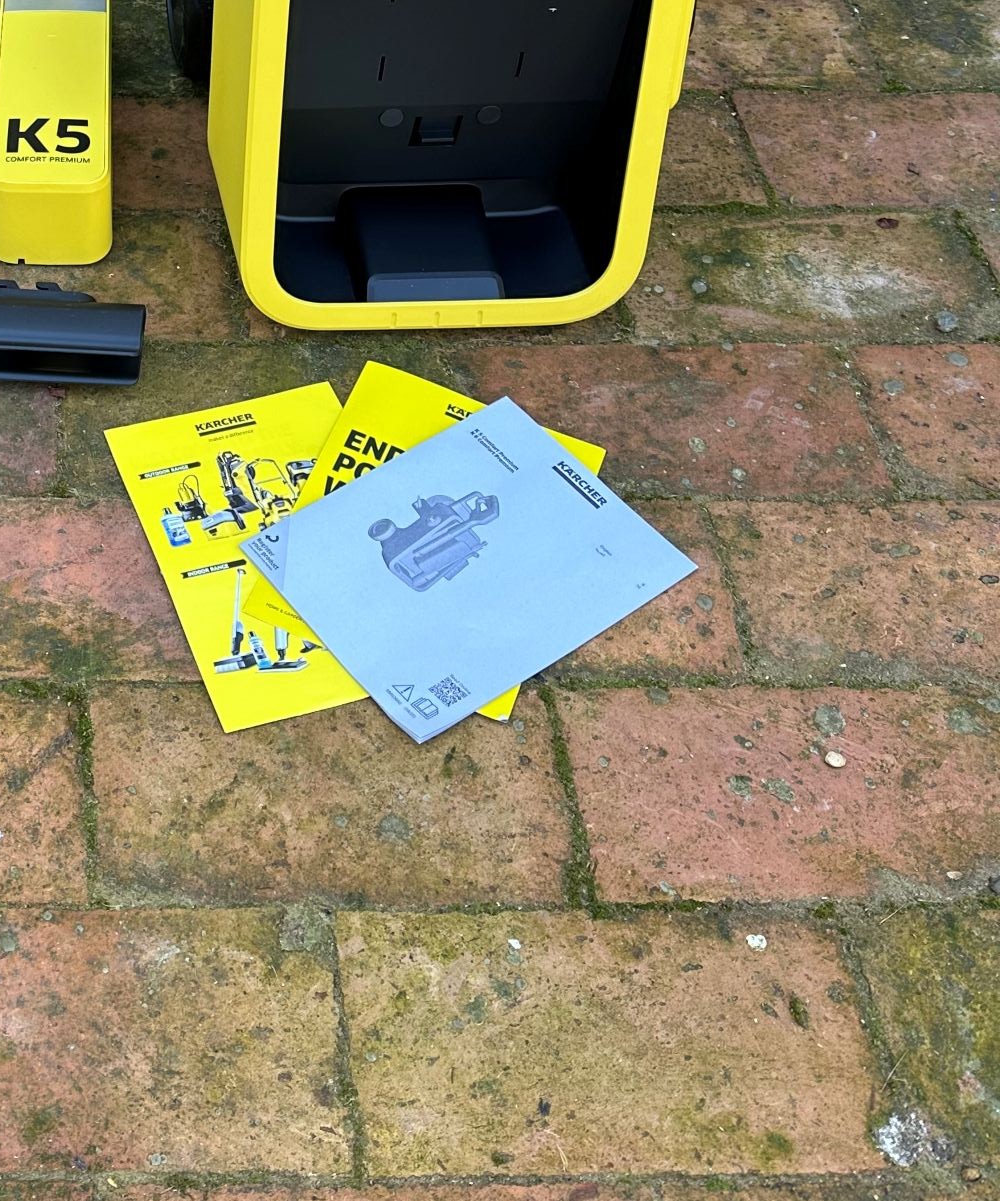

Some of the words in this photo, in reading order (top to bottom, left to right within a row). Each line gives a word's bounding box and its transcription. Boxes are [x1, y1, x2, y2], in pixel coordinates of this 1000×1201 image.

[6, 118, 90, 154] K5
[195, 413, 254, 432] KÄRCHER
[144, 469, 170, 478] OUTDOOR
[557, 460, 608, 507] KÄRCHER
[251, 541, 262, 552] your
[261, 552, 279, 570] product
[256, 537, 275, 557] Register
[187, 567, 210, 578] INDOOR
[210, 563, 229, 573] RANGE
